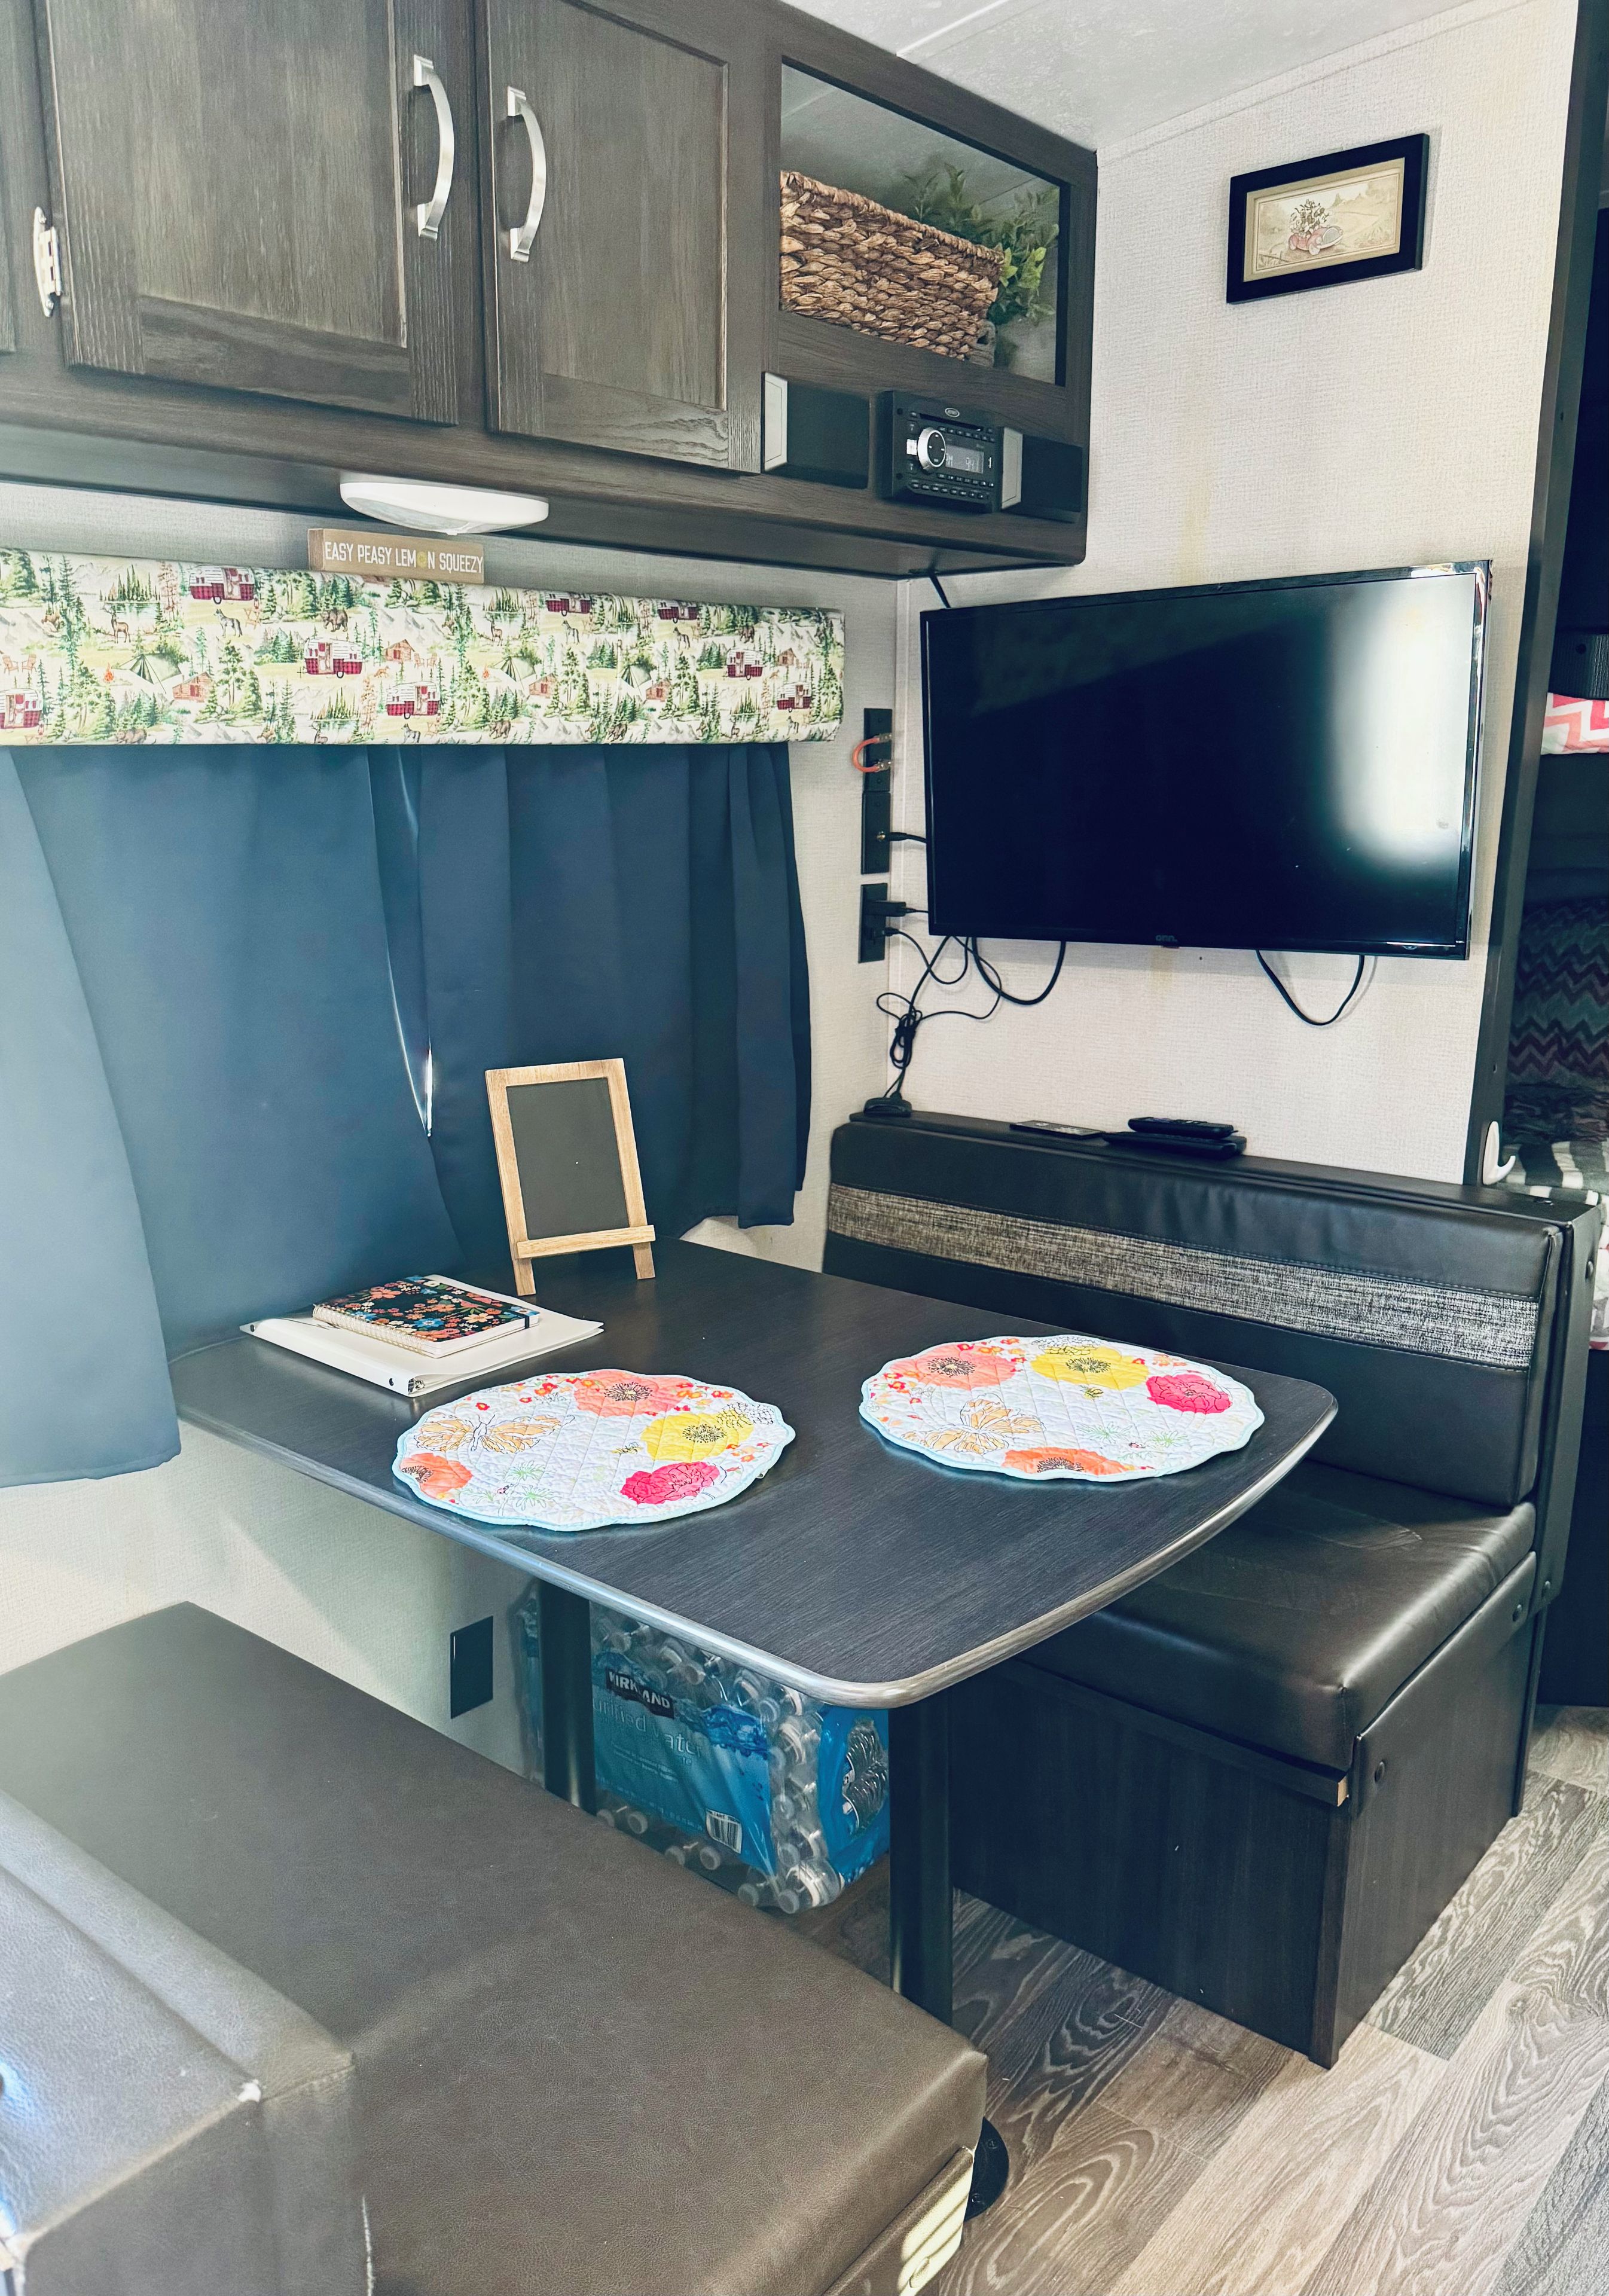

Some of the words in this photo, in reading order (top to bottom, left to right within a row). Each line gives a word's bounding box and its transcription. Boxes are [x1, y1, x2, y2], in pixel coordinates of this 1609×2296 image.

[325, 541, 354, 562] EASY
[358, 544, 392, 565] PEASY
[439, 552, 484, 573] SQUEEZY
[609, 1671, 671, 1709] KIRKAND
